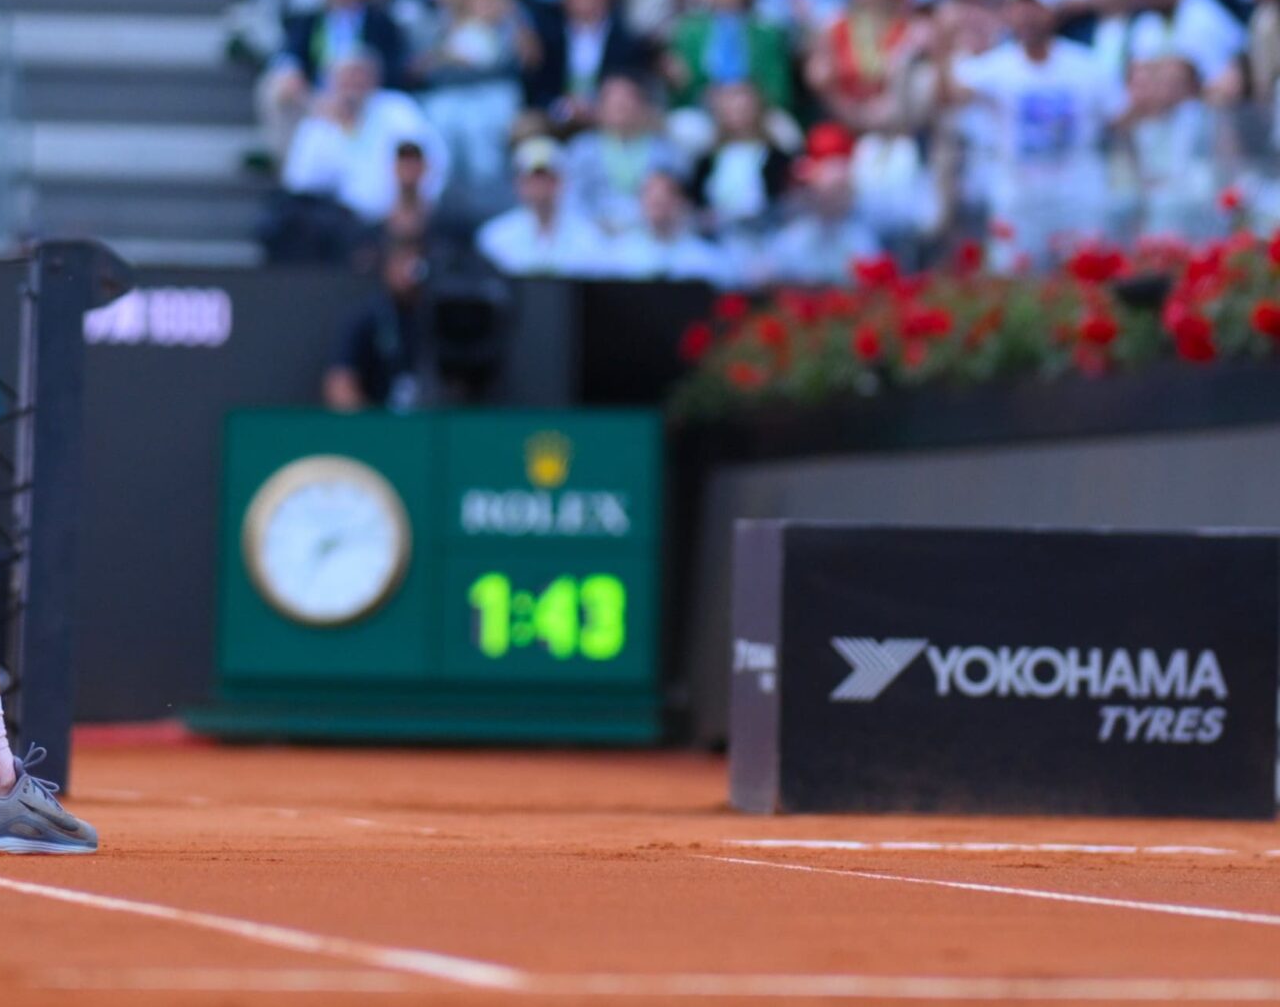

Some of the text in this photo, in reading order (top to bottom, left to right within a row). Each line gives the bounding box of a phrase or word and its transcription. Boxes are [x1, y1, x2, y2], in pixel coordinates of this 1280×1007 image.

[462, 488, 631, 537] ROLEX
[468, 571, 627, 662] 1:43
[926, 644, 1228, 700] YOKOHAMA
[1098, 705, 1228, 744] TYRES
